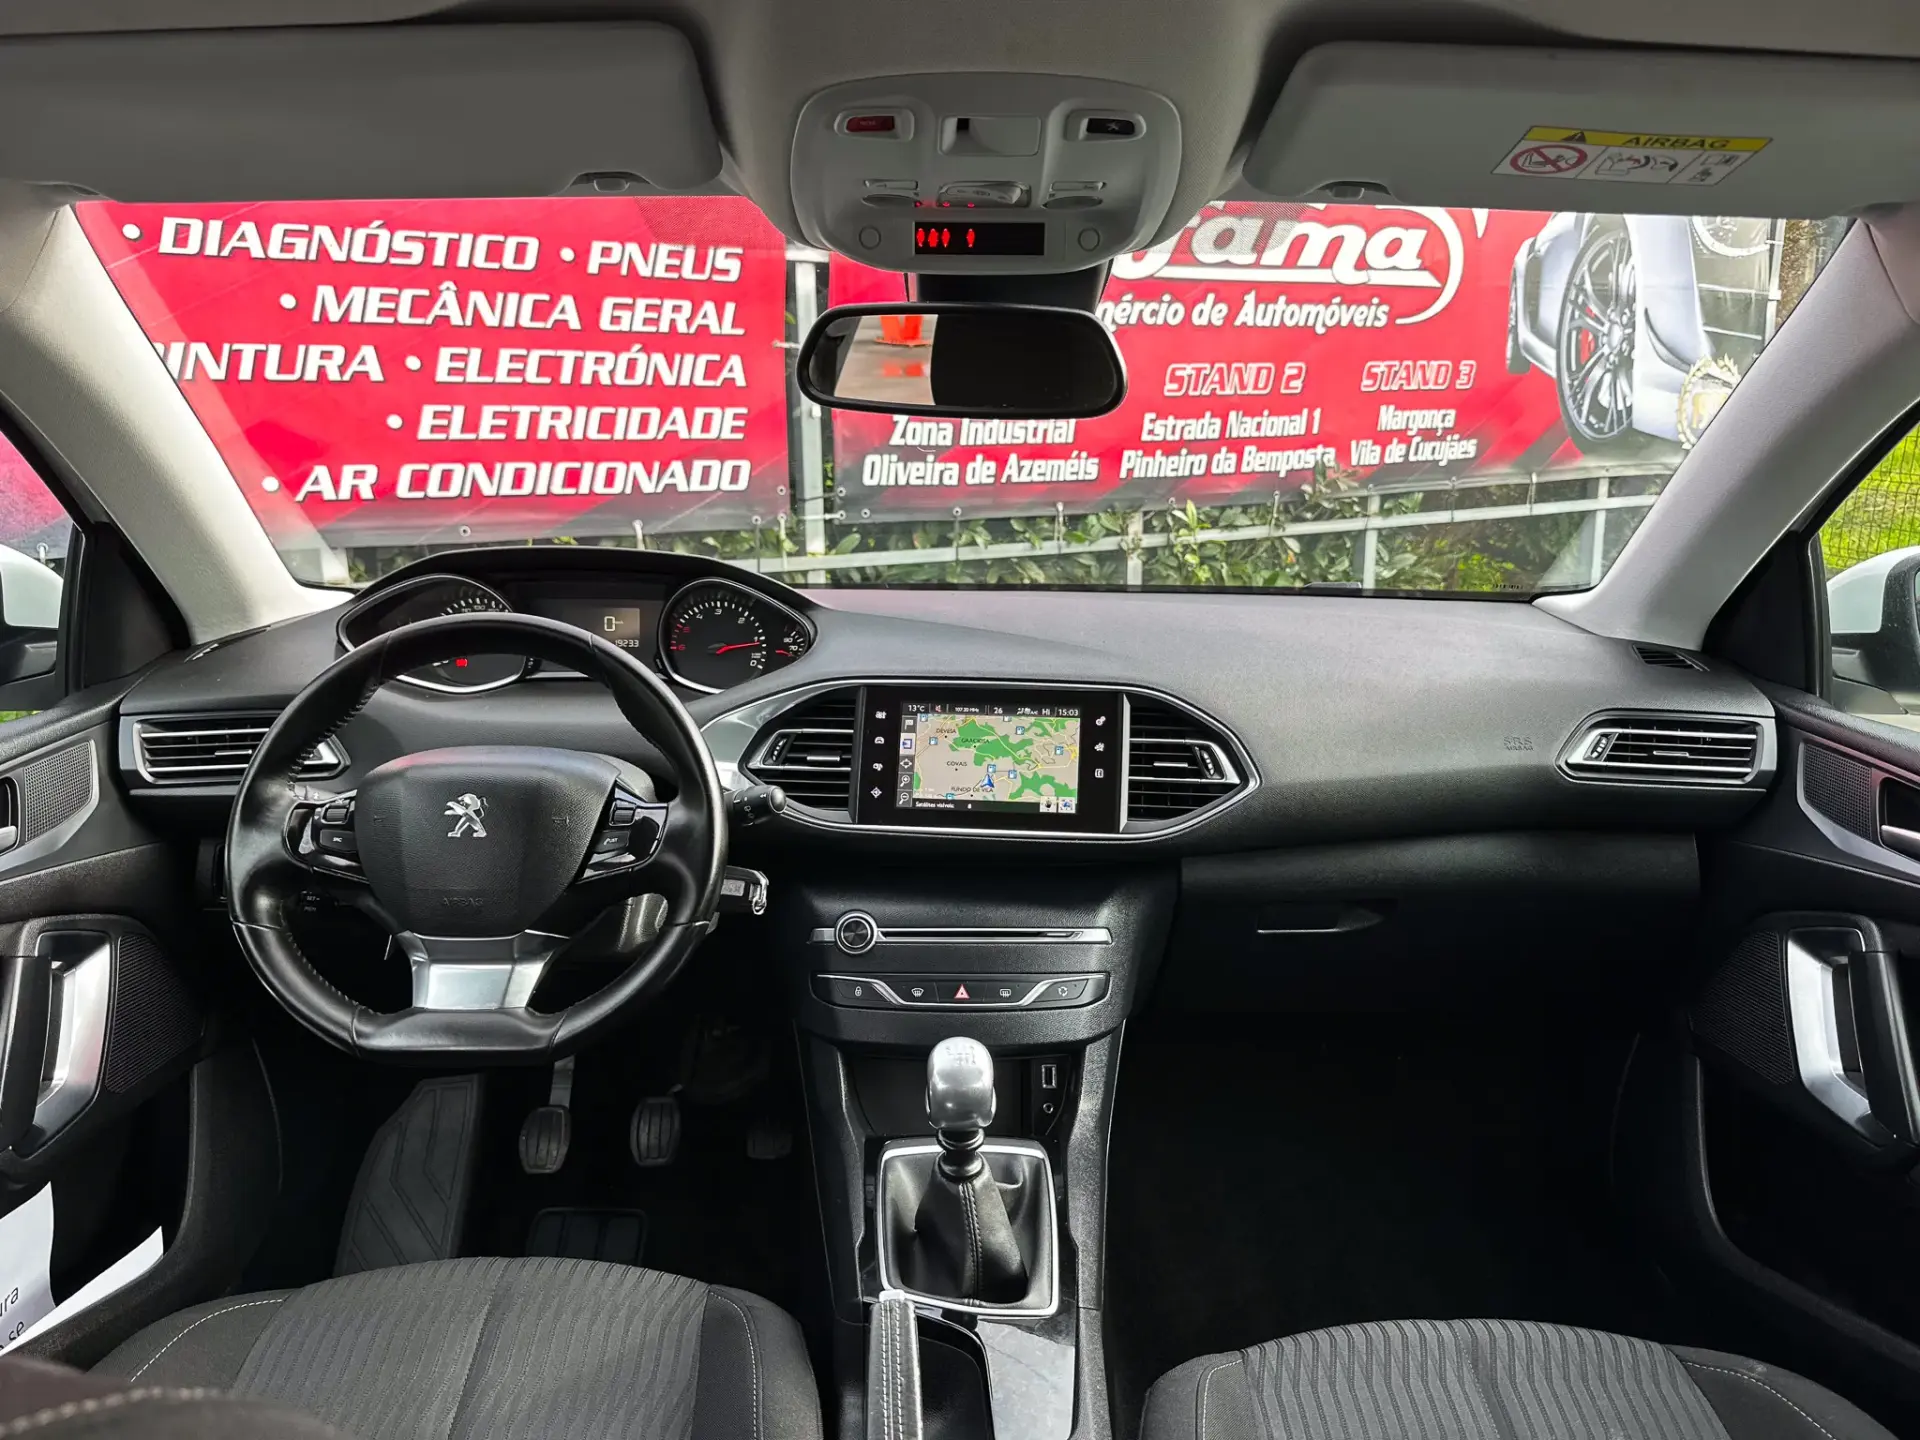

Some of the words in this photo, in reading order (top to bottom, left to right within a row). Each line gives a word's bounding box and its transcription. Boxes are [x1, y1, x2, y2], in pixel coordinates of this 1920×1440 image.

[1622, 136, 1730, 149] AIRBAG
[158, 216, 540, 272] DIAGNÓSTICO
[587, 240, 744, 283] PNEUS
[312, 280, 582, 331] MECÂNICA
[599, 296, 745, 336] GERAL
[1095, 294, 1186, 334] mércio
[1191, 292, 1228, 327] de
[1234, 290, 1390, 335] Automóveis
[435, 343, 747, 388] ELECTRÓNICA
[1163, 362, 1275, 397] STAND
[1280, 362, 1306, 395] 2
[1360, 360, 1451, 392] STAND
[1455, 360, 1477, 390] 3
[417, 405, 748, 441] ELETRICIDADE
[889, 415, 954, 446] Zona
[959, 418, 1077, 446] Industrial
[1141, 411, 1222, 442] Estrada
[1226, 407, 1308, 438] Nacional
[1312, 407, 1322, 435] 1
[1377, 405, 1457, 436] Margonça
[1119, 448, 1208, 479] Pinheiro
[1211, 447, 1237, 474] da
[1241, 445, 1336, 477] Bemposta
[1350, 440, 1382, 466] Vila
[1384, 437, 1407, 464] de
[1408, 434, 1478, 466] Cucujães
[295, 464, 378, 502] AR
[396, 459, 751, 499] CONDICIONADO
[862, 454, 960, 487] Oliveira
[965, 454, 997, 485] de
[1000, 450, 1100, 484] Azeméis
[604, 616, 615, 631] 0
[908, 703, 926, 712] 13°C
[993, 706, 1003, 714] 26
[1058, 708, 1079, 717] 15:03
